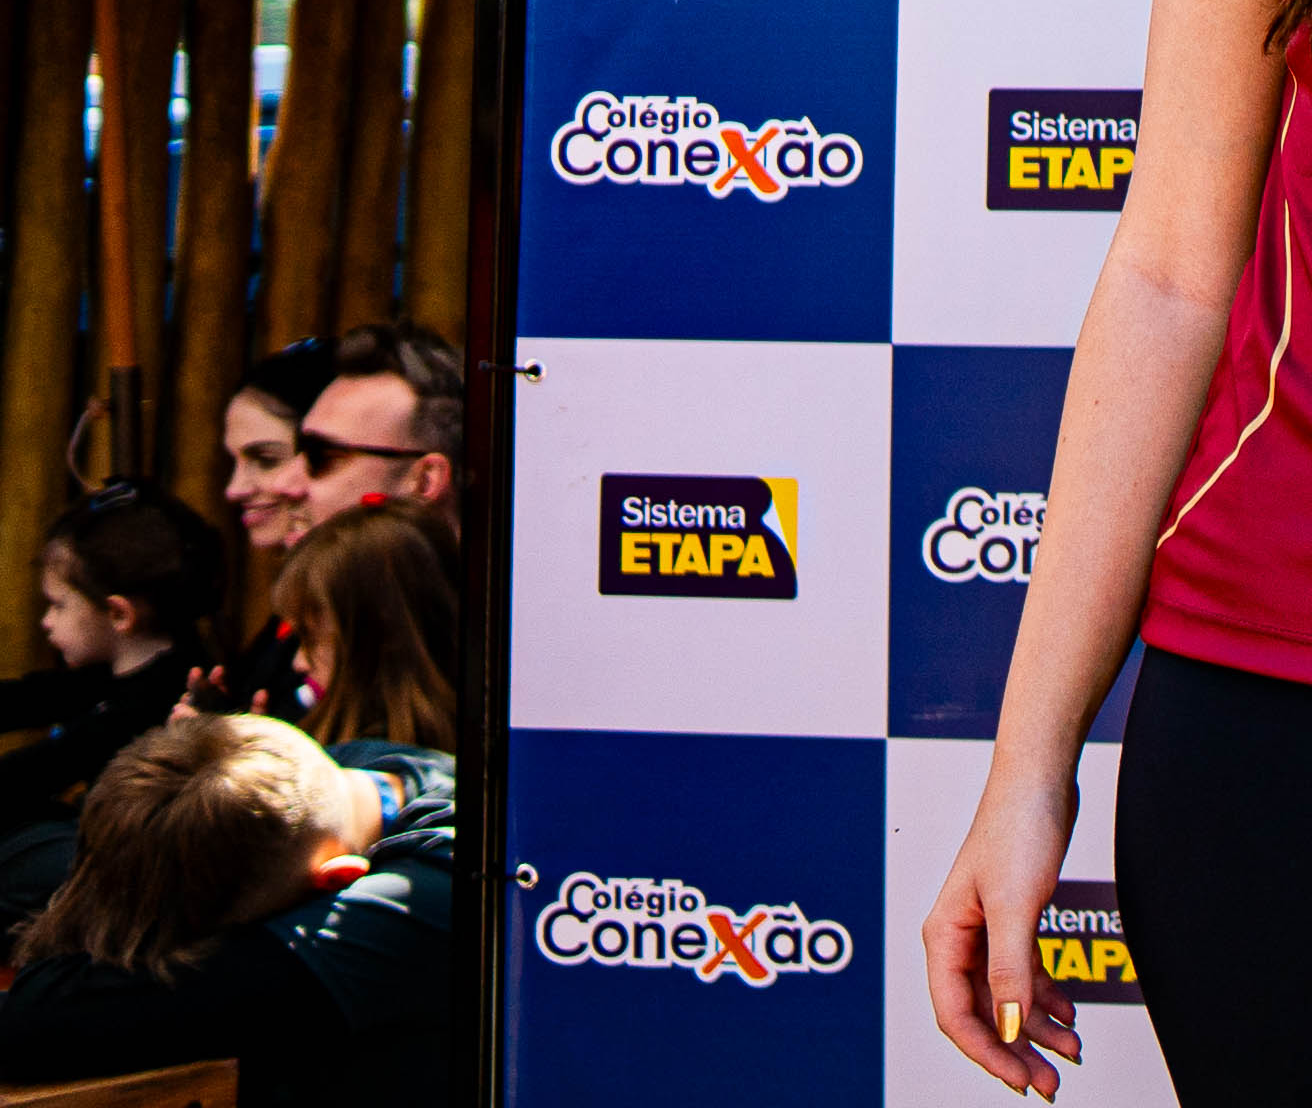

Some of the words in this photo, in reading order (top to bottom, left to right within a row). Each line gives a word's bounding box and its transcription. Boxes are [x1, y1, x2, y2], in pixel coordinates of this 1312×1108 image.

[582, 98, 713, 135] Colégio
[1010, 110, 1137, 141] Sistema
[1009, 146, 1136, 190] ETAP
[622, 496, 746, 528] Sistema
[620, 532, 775, 578] ETAPA
[566, 879, 699, 917] Colégio
[1037, 938, 1138, 983] TAP
